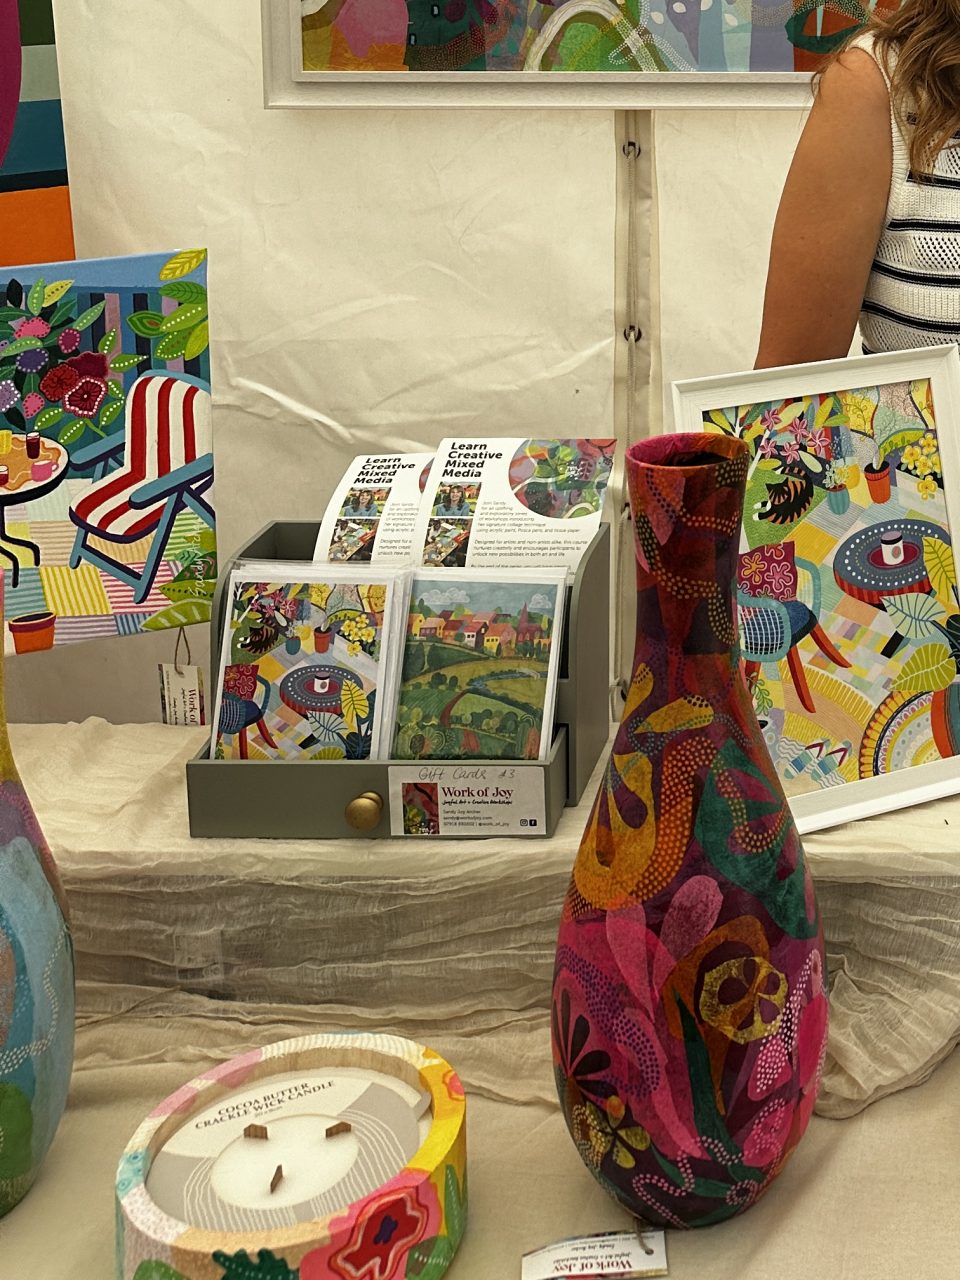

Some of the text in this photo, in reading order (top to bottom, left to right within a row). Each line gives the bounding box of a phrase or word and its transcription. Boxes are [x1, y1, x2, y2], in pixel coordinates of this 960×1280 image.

[450, 442, 487, 450] Learn
[448, 451, 503, 460] Creative
[444, 460, 485, 468] Mixed
[441, 469, 482, 478] Media
[188, 689, 198, 712] Work
[418, 766, 444, 781] Gift
[452, 767, 487, 780] Cards
[441, 786, 514, 800] Work of Joy
[195, 1110, 252, 1130] CRACKLE
[252, 1098, 287, 1113] WICK
[288, 1080, 336, 1101] CANDLE
[217, 1098, 260, 1116] COCOA
[262, 1082, 310, 1103] BUTTER
[553, 1259, 633, 1273] Work of Joy
